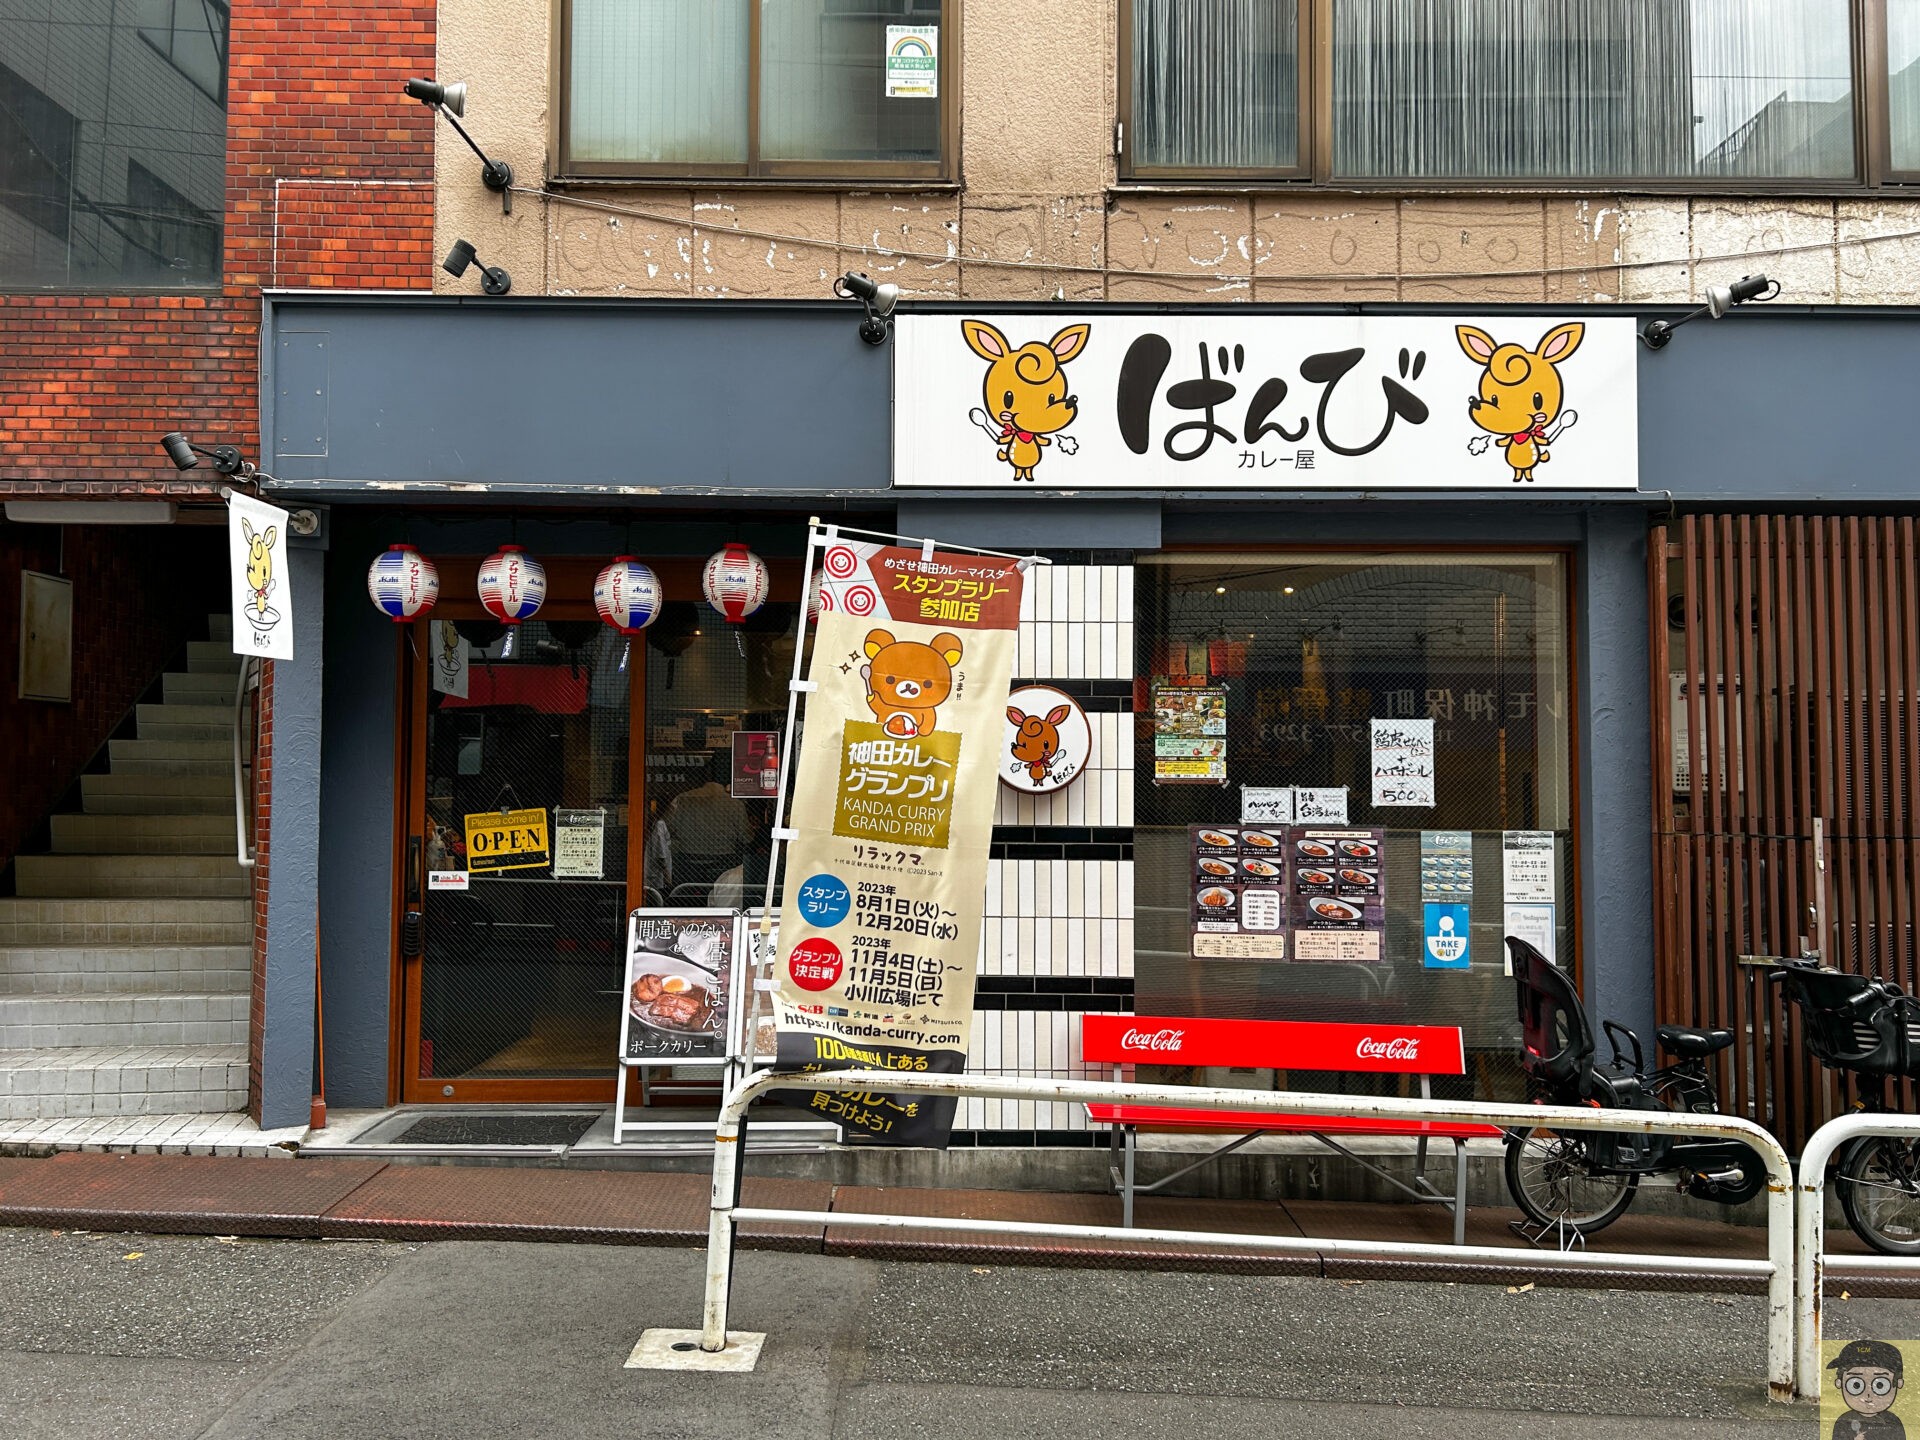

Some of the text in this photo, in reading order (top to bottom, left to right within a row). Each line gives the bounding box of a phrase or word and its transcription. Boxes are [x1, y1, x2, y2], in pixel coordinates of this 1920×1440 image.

[1117, 333, 1429, 461] ばんび
[1238, 450, 1315, 469] カレー屋
[509, 560, 518, 602] アサヒビール
[708, 559, 718, 601] アサヒビール
[725, 575, 746, 583] Asahi
[884, 558, 1014, 580] めざせ神田カレーマイスター
[408, 562, 419, 604] アサヒビール
[613, 571, 624, 614] アサヒビール
[632, 585, 652, 595] Asahi
[750, 562, 762, 604] アサヒビール
[893, 574, 1010, 600] スタンプラリー
[919, 598, 981, 622] 参加店
[848, 740, 951, 768] 神田カレー
[1375, 763, 1433, 778] ハイボール
[845, 766, 949, 802] グランプリ
[471, 818, 501, 827] Please
[502, 815, 527, 825] come
[843, 797, 946, 822] KANDA CURRY
[849, 814, 936, 838] GRAND PRIX
[853, 844, 922, 866] リラックマ
[803, 886, 848, 901] スタンプ
[857, 882, 896, 896] 2023年
[807, 901, 839, 914] ラリー
[638, 919, 730, 941] 間違いのない、
[855, 912, 959, 941] 12月20日(水)
[851, 935, 891, 950] 2023年
[1435, 940, 1459, 948] TAKE
[792, 949, 841, 966] グランプリ
[794, 965, 835, 981] 決定戦
[848, 966, 943, 992] 11月5日(日)
[702, 941, 729, 1040] 昼ごはん。
[844, 984, 944, 1008] 小川広場にて
[798, 1004, 824, 1015] S&B
[785, 1012, 961, 1046] https://kanda-curry.com
[1121, 1028, 1186, 1051] Coca-Cola
[630, 1039, 707, 1054] ポークカリー
[1356, 1037, 1421, 1061] Coca-Cola
[810, 1091, 893, 1133] 見つけよう!
